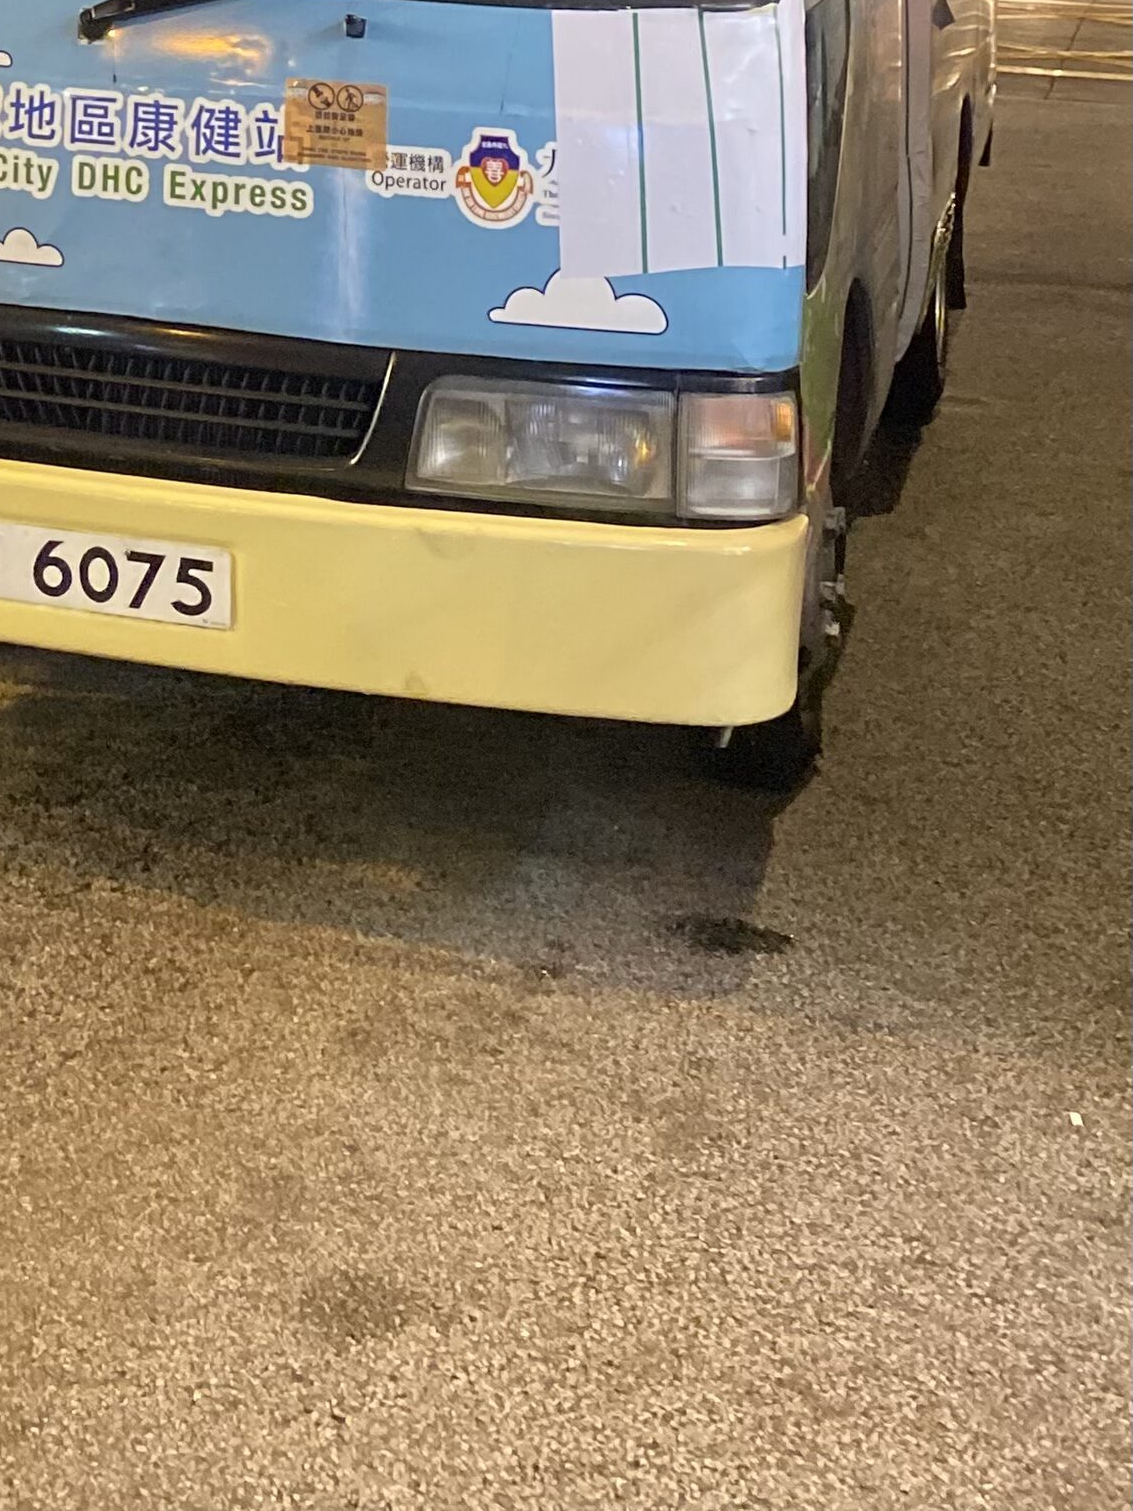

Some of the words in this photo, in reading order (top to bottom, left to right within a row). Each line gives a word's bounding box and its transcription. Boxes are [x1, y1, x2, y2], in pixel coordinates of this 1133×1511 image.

[371, 170, 447, 192] Operator
[385, 152, 445, 174] 運機構
[76, 160, 144, 197] DHC
[168, 170, 309, 213] Express
[32, 539, 215, 617] 6075
